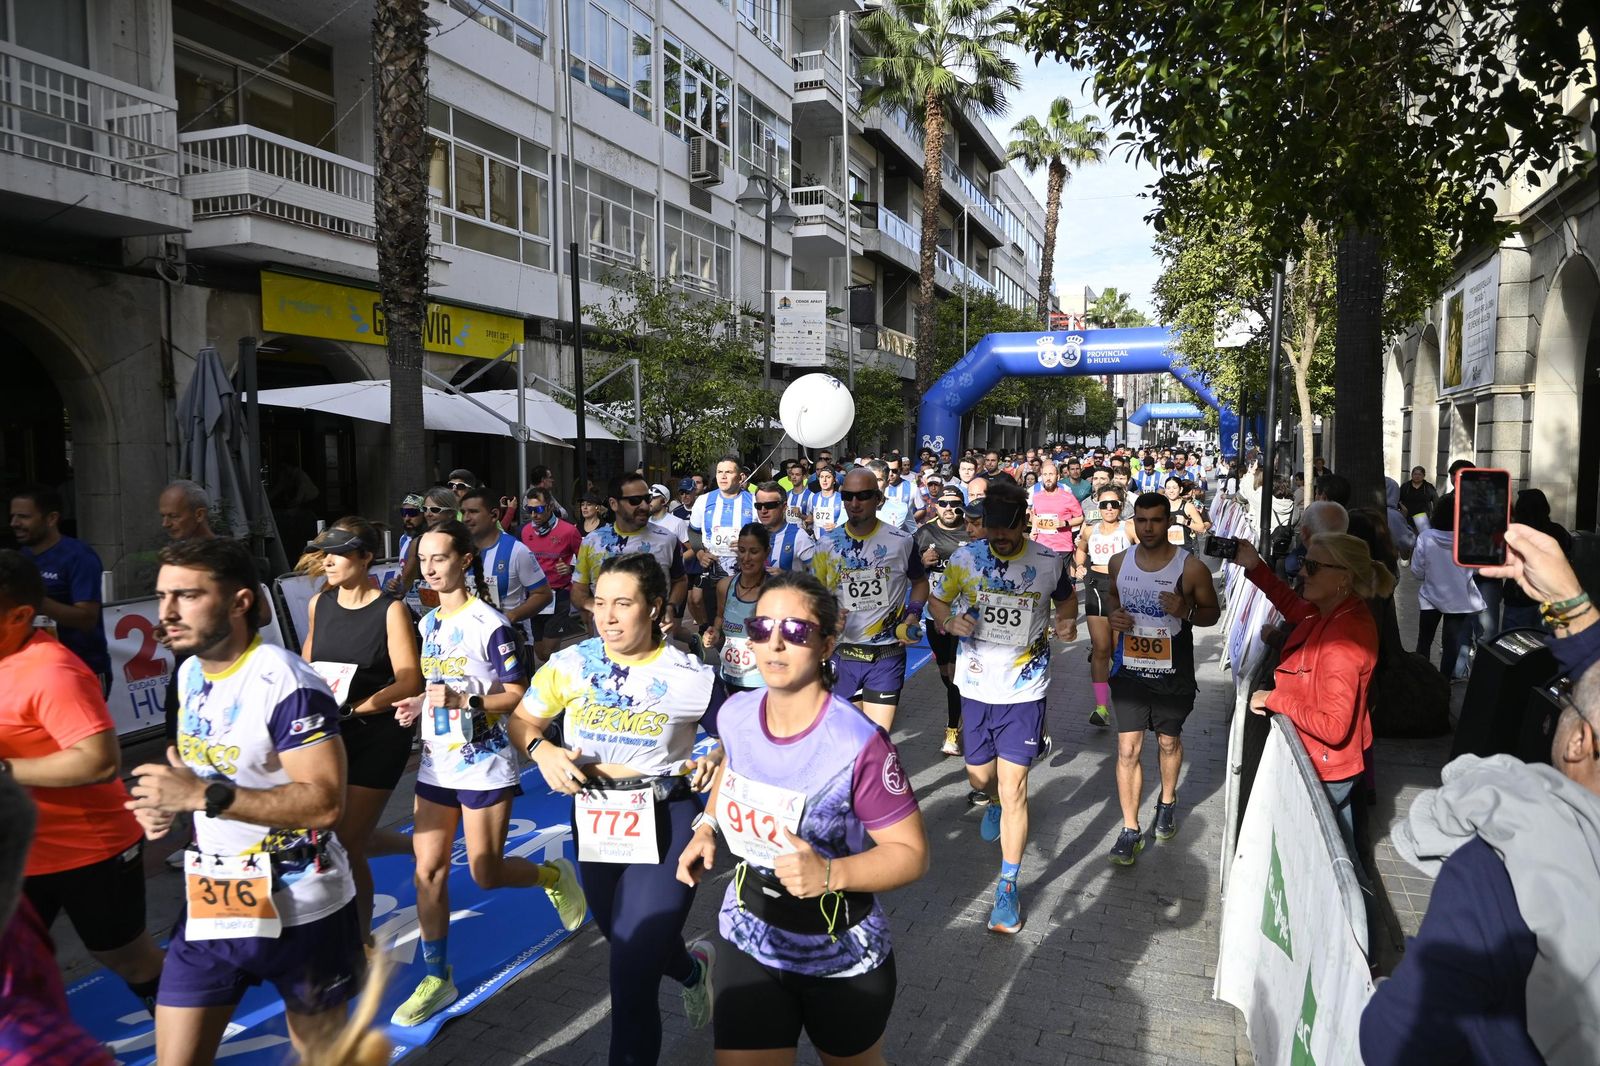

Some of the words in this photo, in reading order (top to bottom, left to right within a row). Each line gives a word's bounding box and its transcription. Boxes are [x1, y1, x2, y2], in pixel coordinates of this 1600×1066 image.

[1087, 350, 1128, 358] PROVINCIAL
[815, 511, 830, 520] 872
[1094, 544, 1116, 555] 861
[848, 580, 883, 598] 623
[984, 606, 1022, 627] 593
[1130, 637, 1163, 654] 396
[725, 648, 750, 666] 635
[576, 703, 670, 737] HERMES
[587, 809, 641, 837] 772
[727, 800, 784, 849] 912
[198, 877, 257, 908] 376
